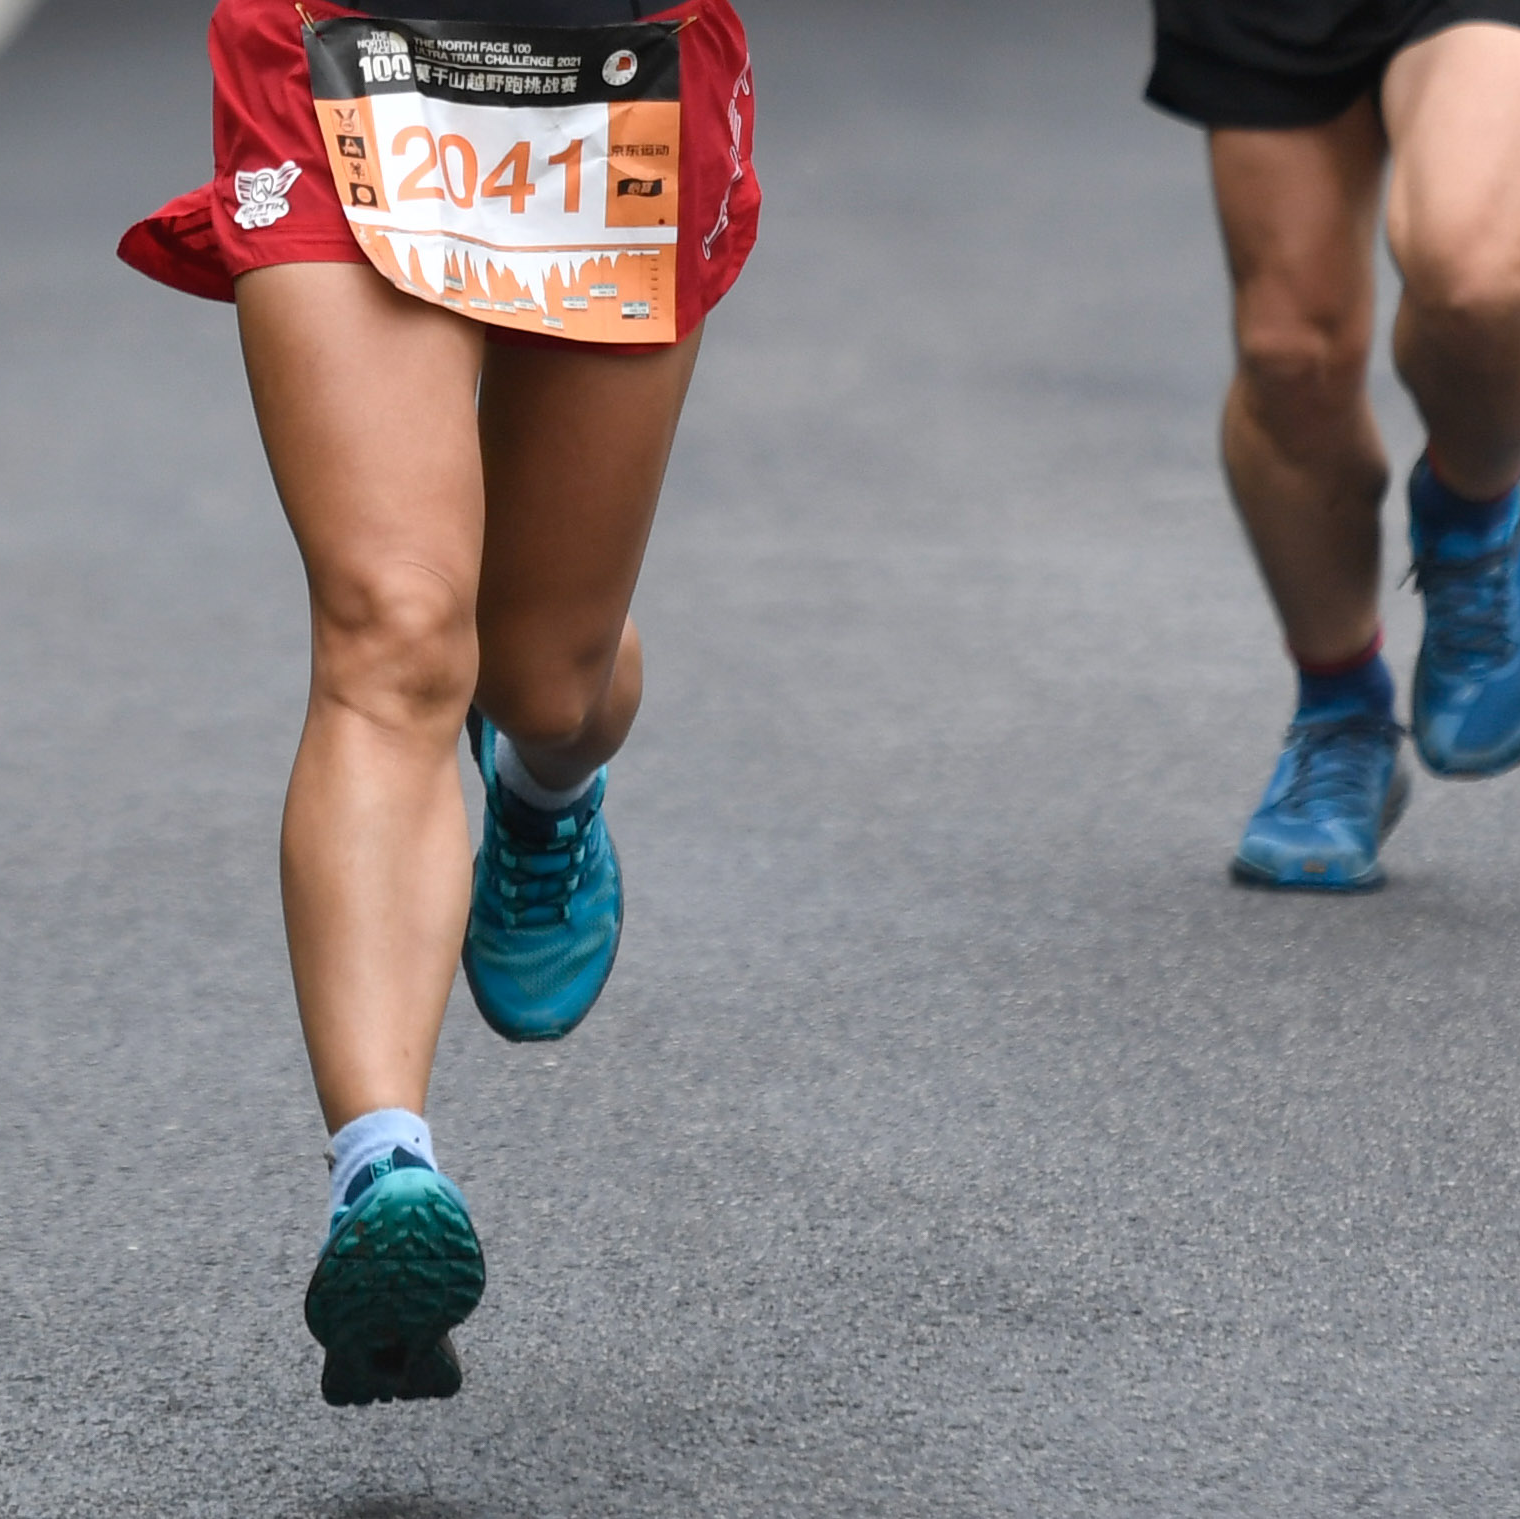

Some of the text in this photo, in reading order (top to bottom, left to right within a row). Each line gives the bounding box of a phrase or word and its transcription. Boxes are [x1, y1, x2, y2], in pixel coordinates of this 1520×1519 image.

[414, 36, 531, 55] THE NORTH FACE 100
[415, 46, 582, 68] ULTRA TRAIL CHALLENGE 2021
[358, 54, 413, 83] 100
[414, 63, 579, 95] 莫干山越野跑挑战赛
[610, 144, 670, 157] 京东运动
[391, 125, 584, 214] 2041
